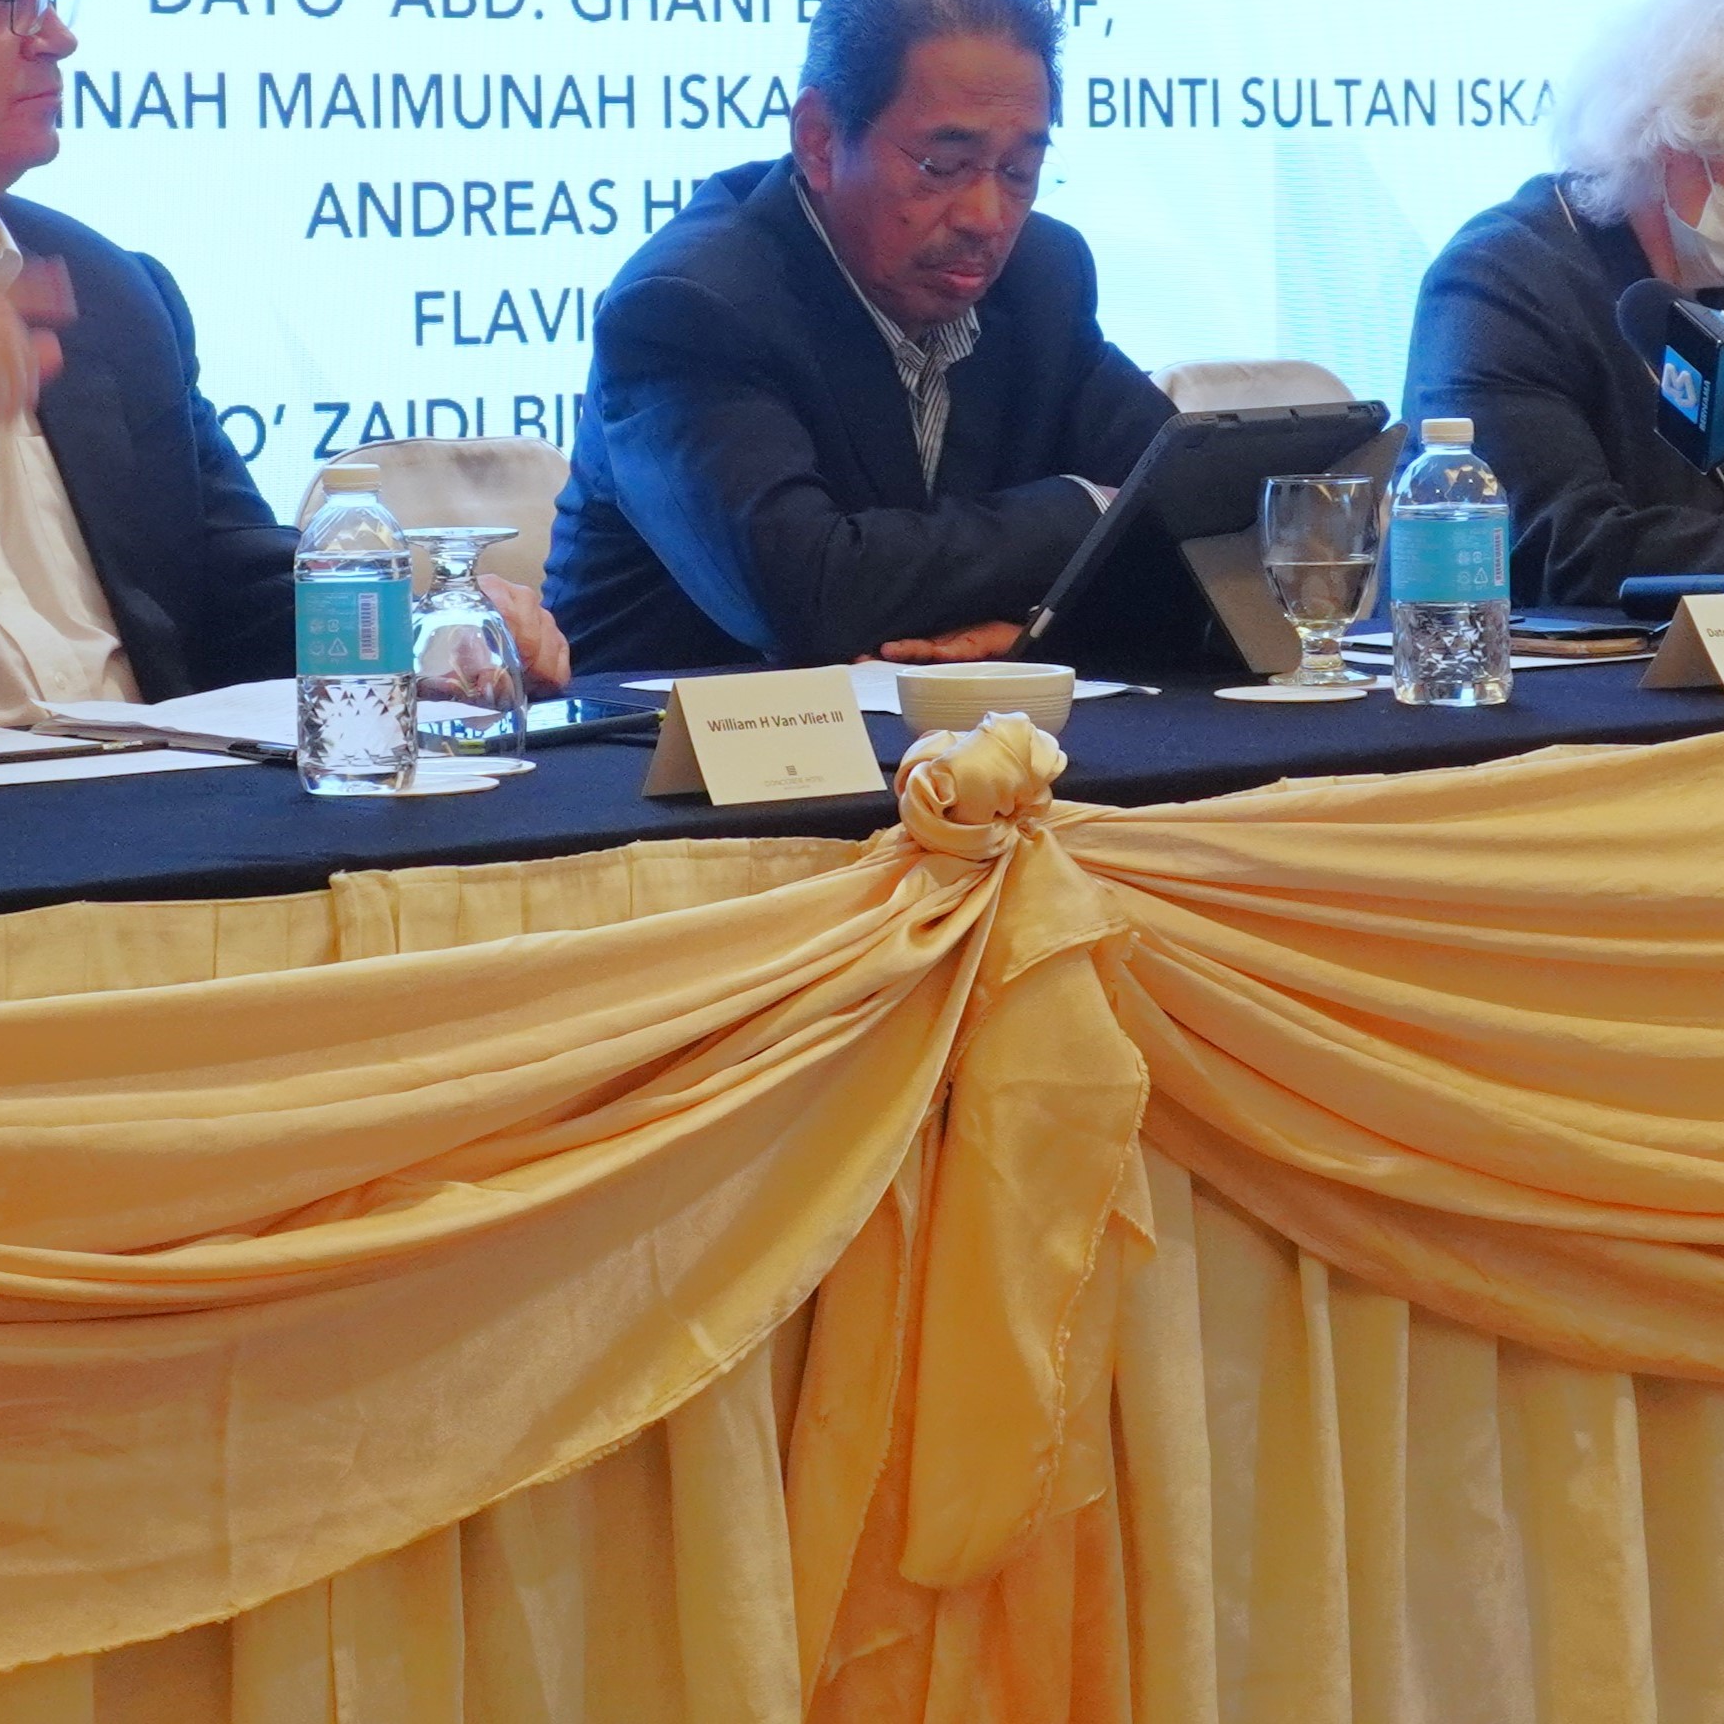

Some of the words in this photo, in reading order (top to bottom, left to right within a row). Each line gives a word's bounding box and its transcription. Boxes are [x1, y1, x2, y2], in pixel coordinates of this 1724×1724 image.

[54, 69, 228, 131] NAH
[257, 71, 637, 131] MAIMUNAH
[662, 73, 794, 131] ISKA
[1086, 76, 1221, 130] BINTI
[1239, 75, 1438, 132] SULTAN
[1456, 76, 1558, 129] ISKA
[303, 177, 620, 241] ANDREAS
[413, 285, 606, 348] FLAVI
[311, 395, 486, 463] ZAIDI
[512, 392, 584, 454] BI
[1699, 378, 1712, 433] BERNAMA
[707, 718, 758, 733] William
[759, 716, 771, 728] H
[771, 714, 798, 727] Van
[798, 711, 830, 725] Vliet
[830, 710, 845, 723] III
